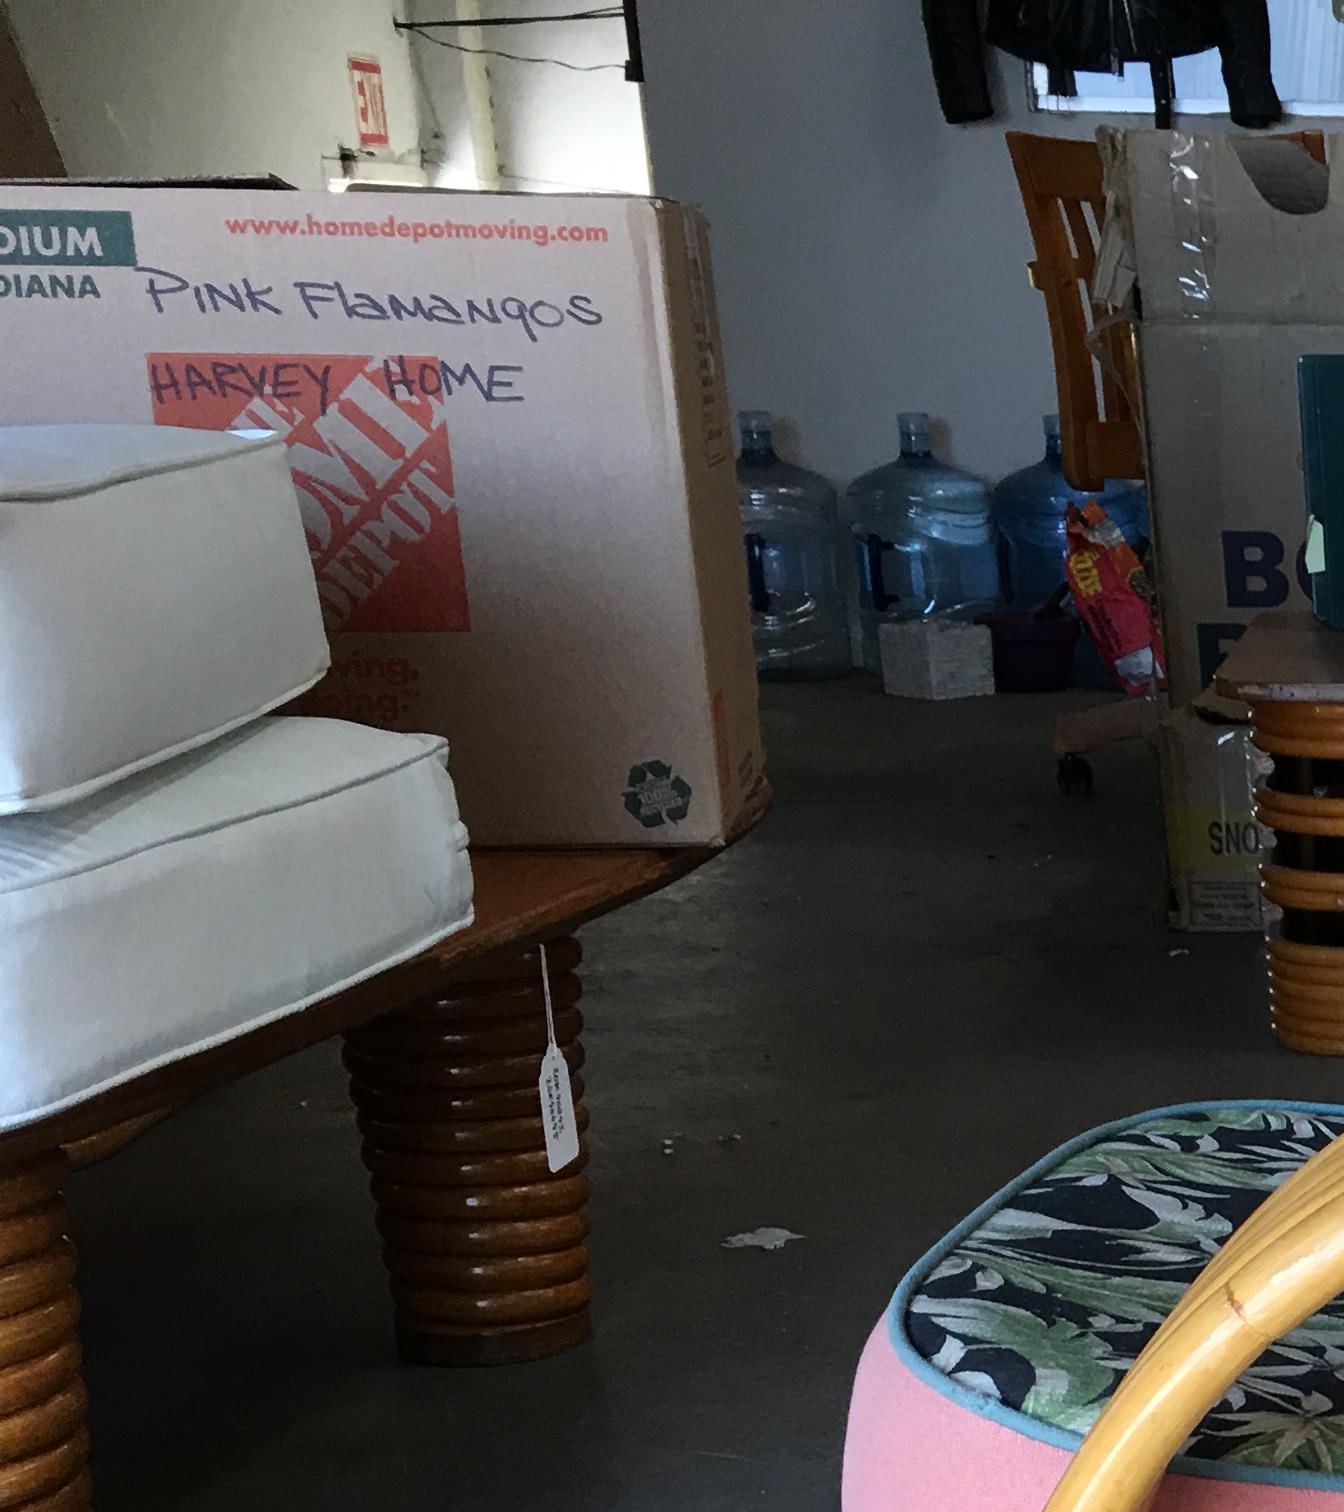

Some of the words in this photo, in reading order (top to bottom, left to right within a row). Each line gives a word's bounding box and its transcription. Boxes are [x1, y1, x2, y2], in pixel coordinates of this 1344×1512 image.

[224, 214, 609, 246] www.homedepotmoving.com
[149, 359, 333, 416] HARVEY
[382, 354, 525, 403] HOME
